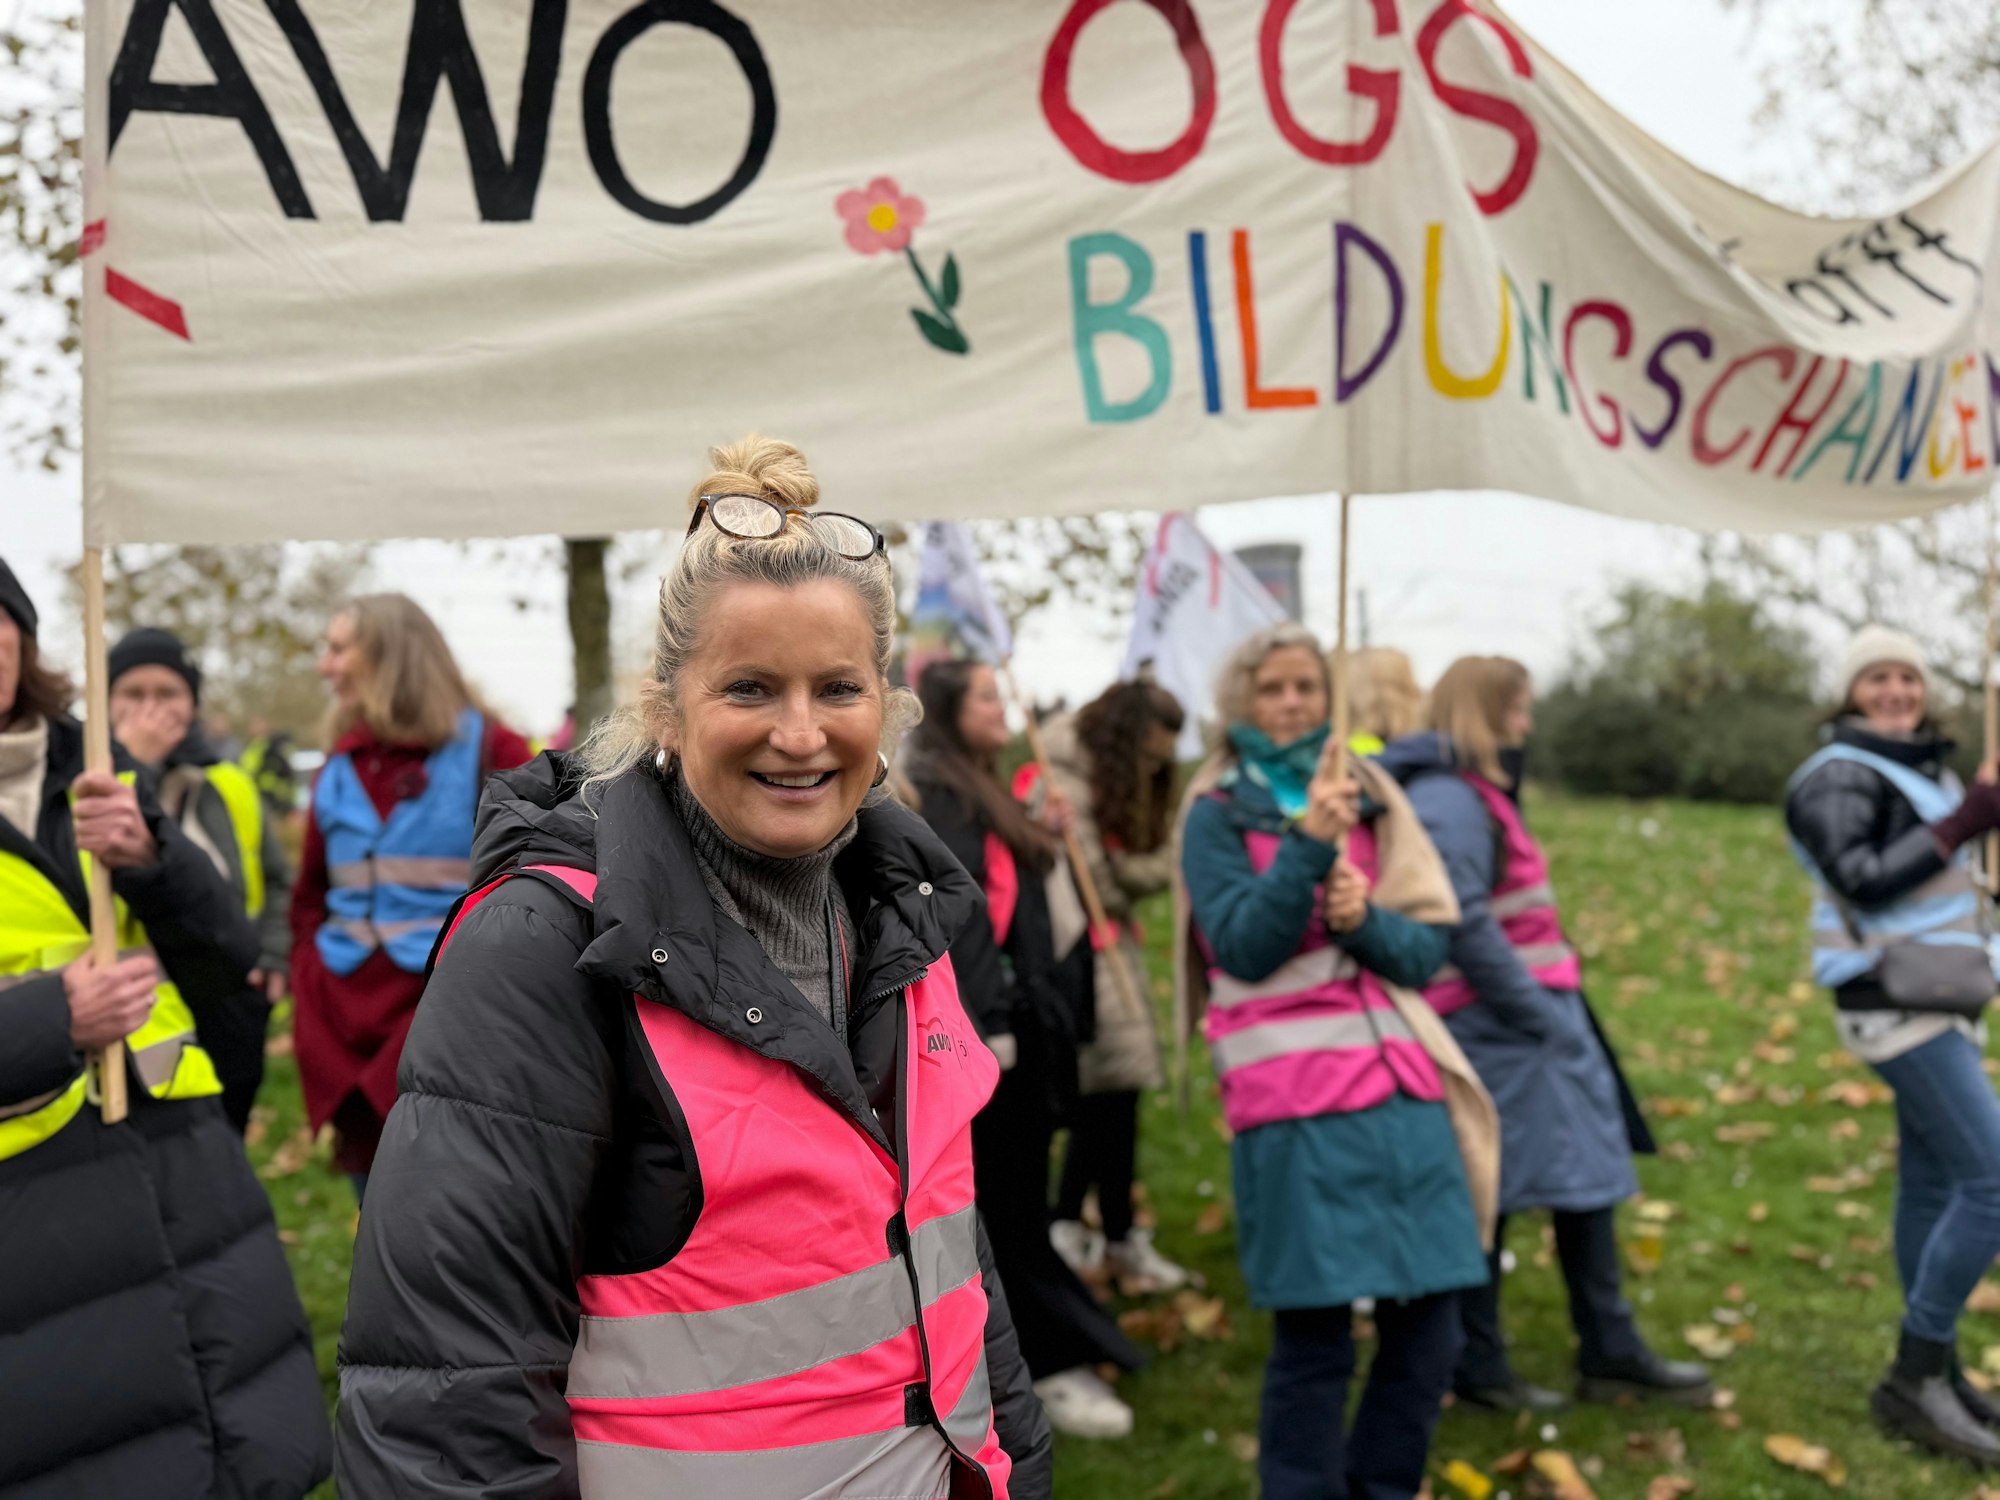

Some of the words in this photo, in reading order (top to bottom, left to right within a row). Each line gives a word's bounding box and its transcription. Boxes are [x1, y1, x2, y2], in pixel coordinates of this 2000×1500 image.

[108, 0, 778, 225] AWO
[1040, 0, 1540, 216] OGS
[927, 1033, 952, 1053] AWO
